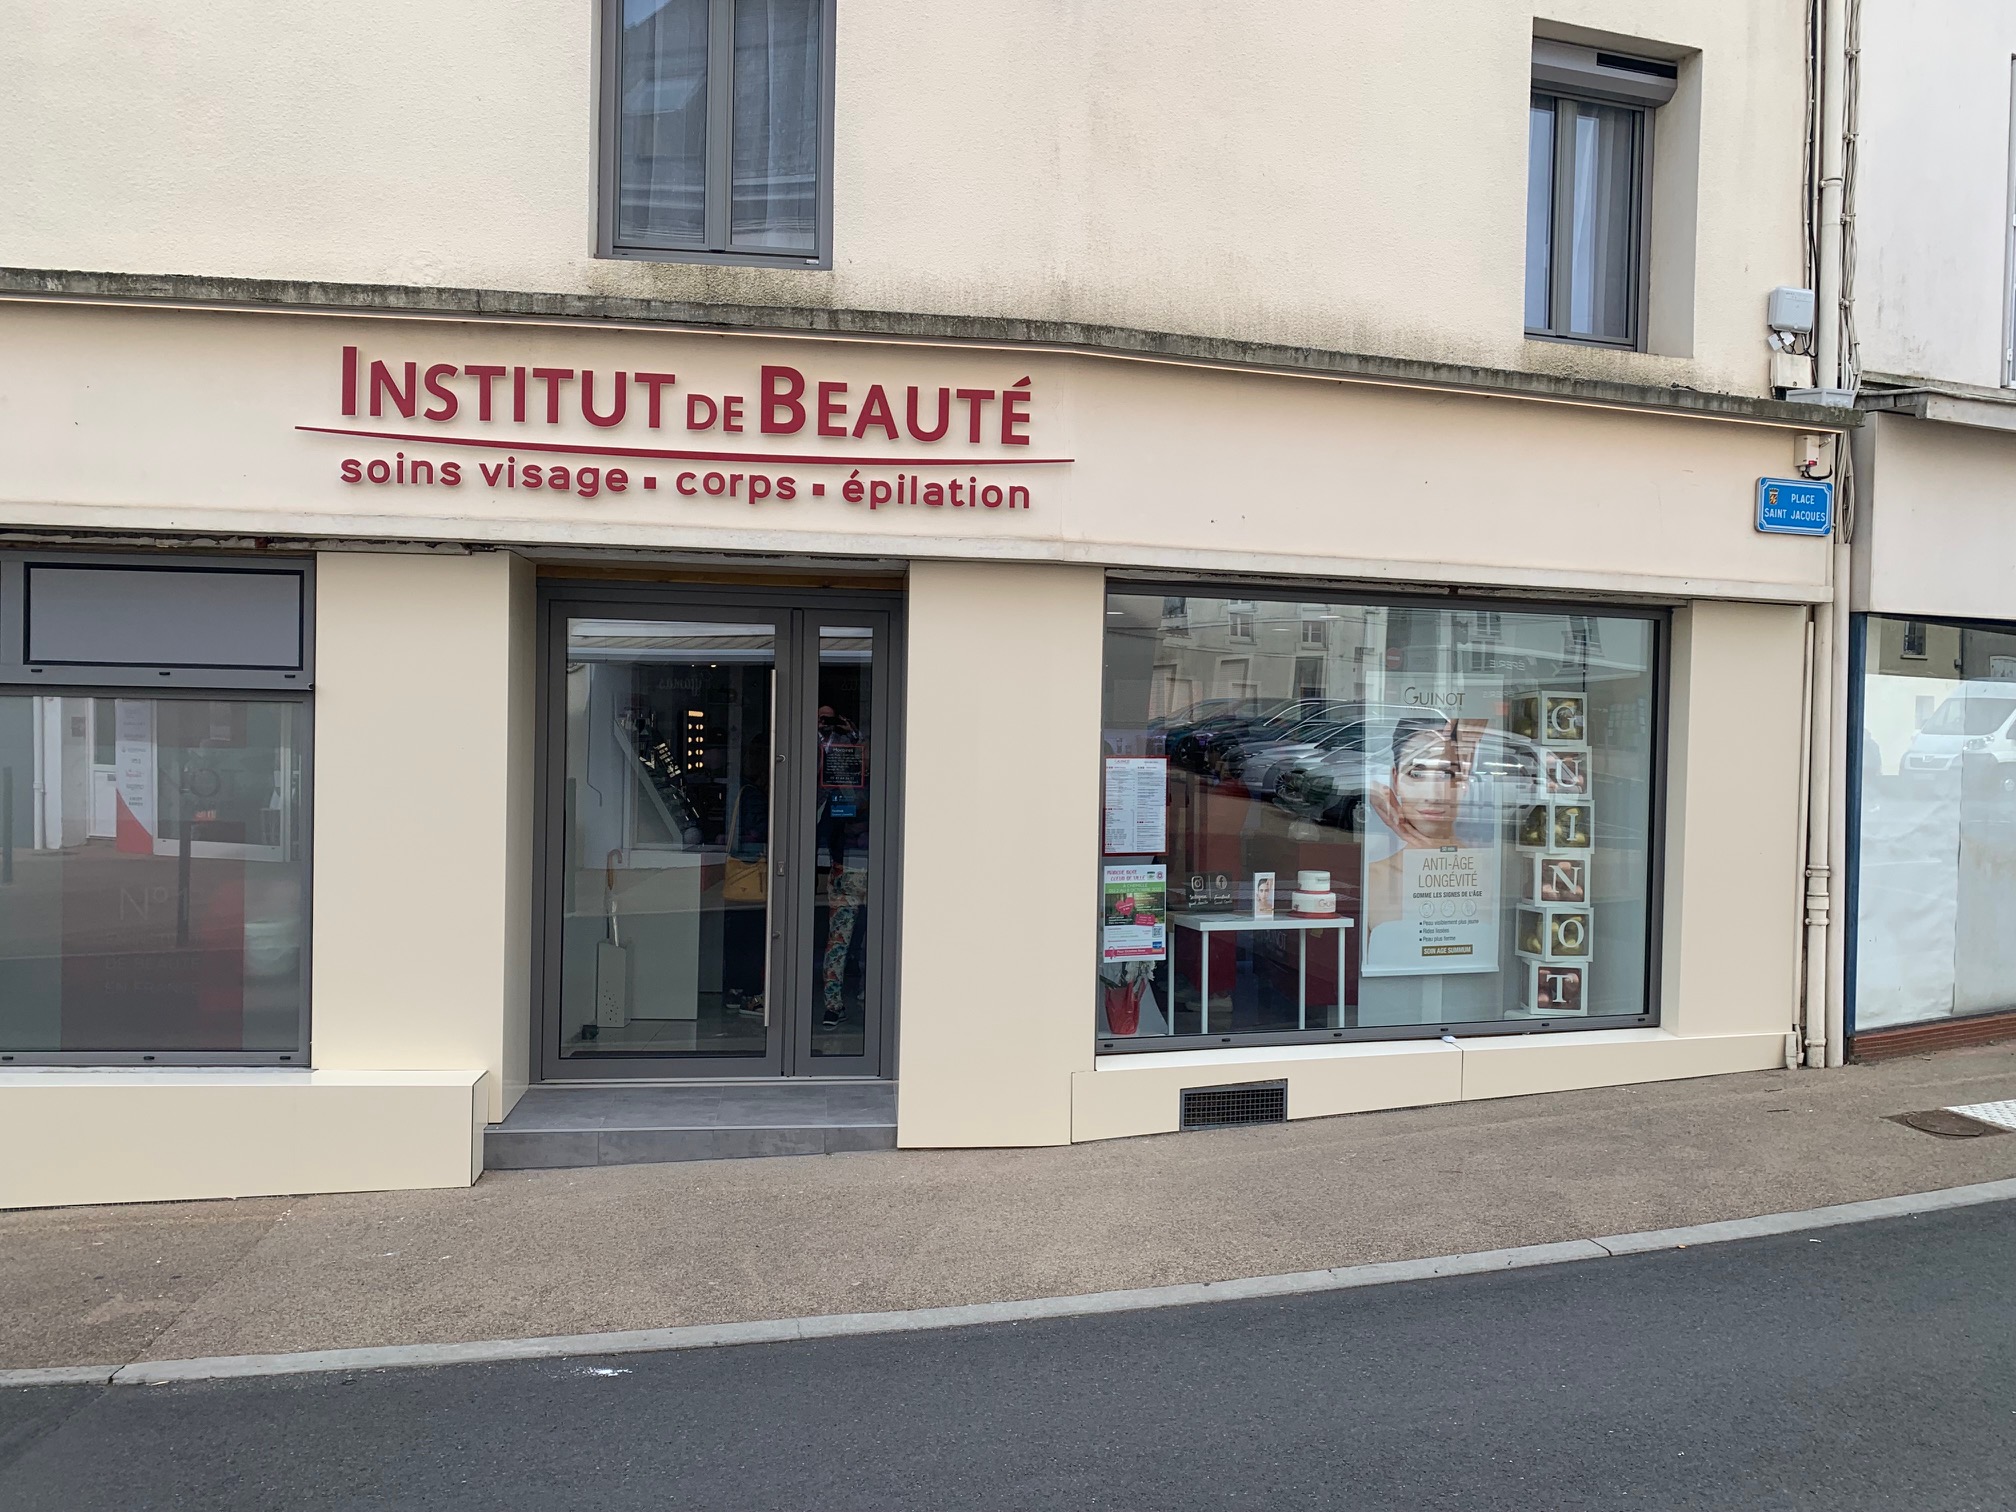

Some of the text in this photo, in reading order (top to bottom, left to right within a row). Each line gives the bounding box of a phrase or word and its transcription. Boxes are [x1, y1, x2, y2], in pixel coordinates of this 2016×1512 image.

[341, 346, 1031, 445] INSTITUT DE BEAUTÉ
[340, 452, 1030, 510] soins visage corps épilation
[1791, 494, 1815, 505] PLACE
[1764, 508, 1826, 522] SAINT JACQUES
[1403, 686, 1466, 706] GUINOT
[1422, 854, 1474, 871] ANTI-ÂGE
[1418, 871, 1478, 888] LONGÉVITÉ
